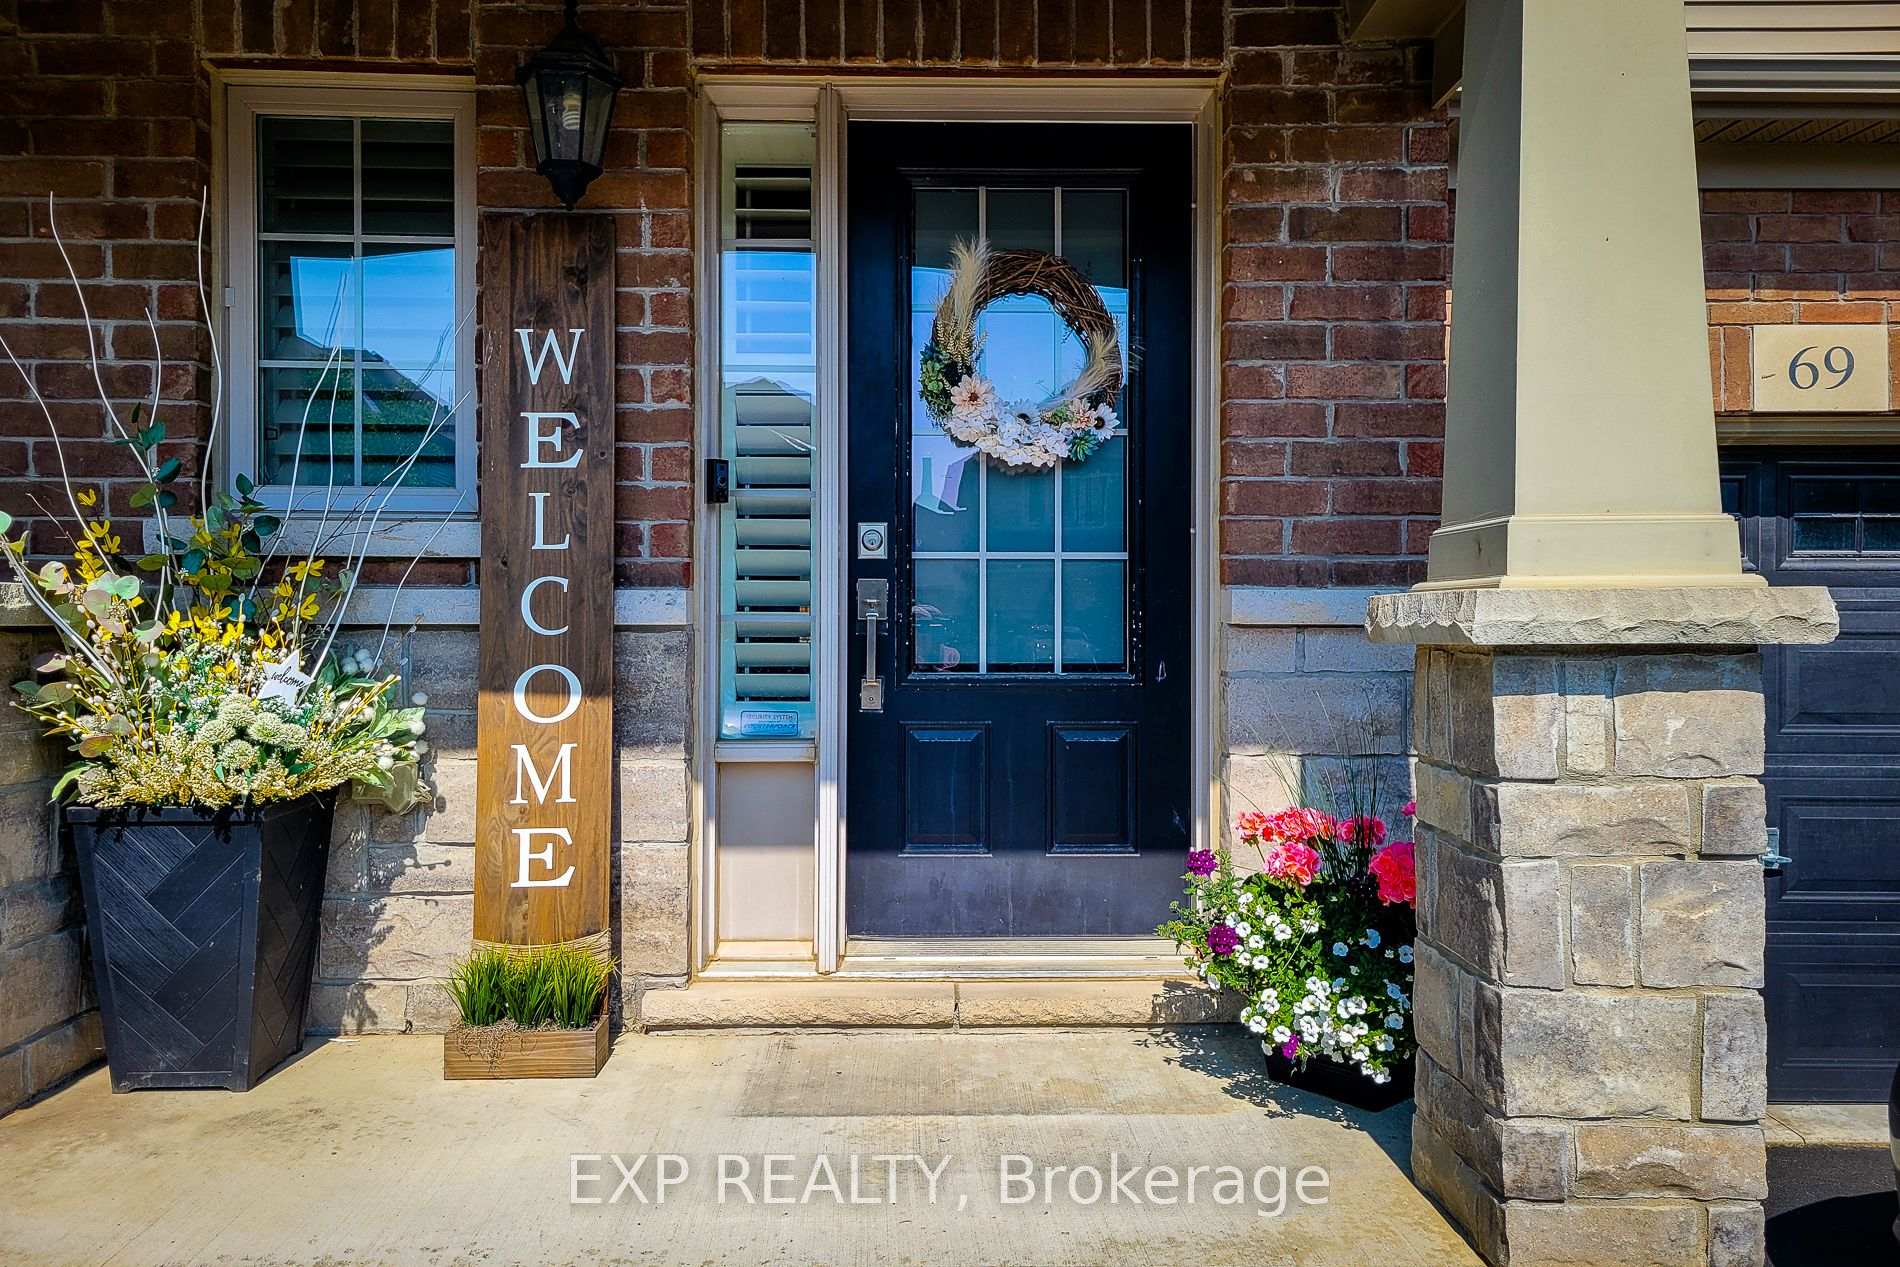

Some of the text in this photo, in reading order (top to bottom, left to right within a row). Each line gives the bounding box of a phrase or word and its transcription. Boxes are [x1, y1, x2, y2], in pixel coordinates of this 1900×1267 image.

[1788, 345, 1855, 390] 69
[509, 328, 586, 889] WELCOME
[270, 665, 306, 688] welcome
